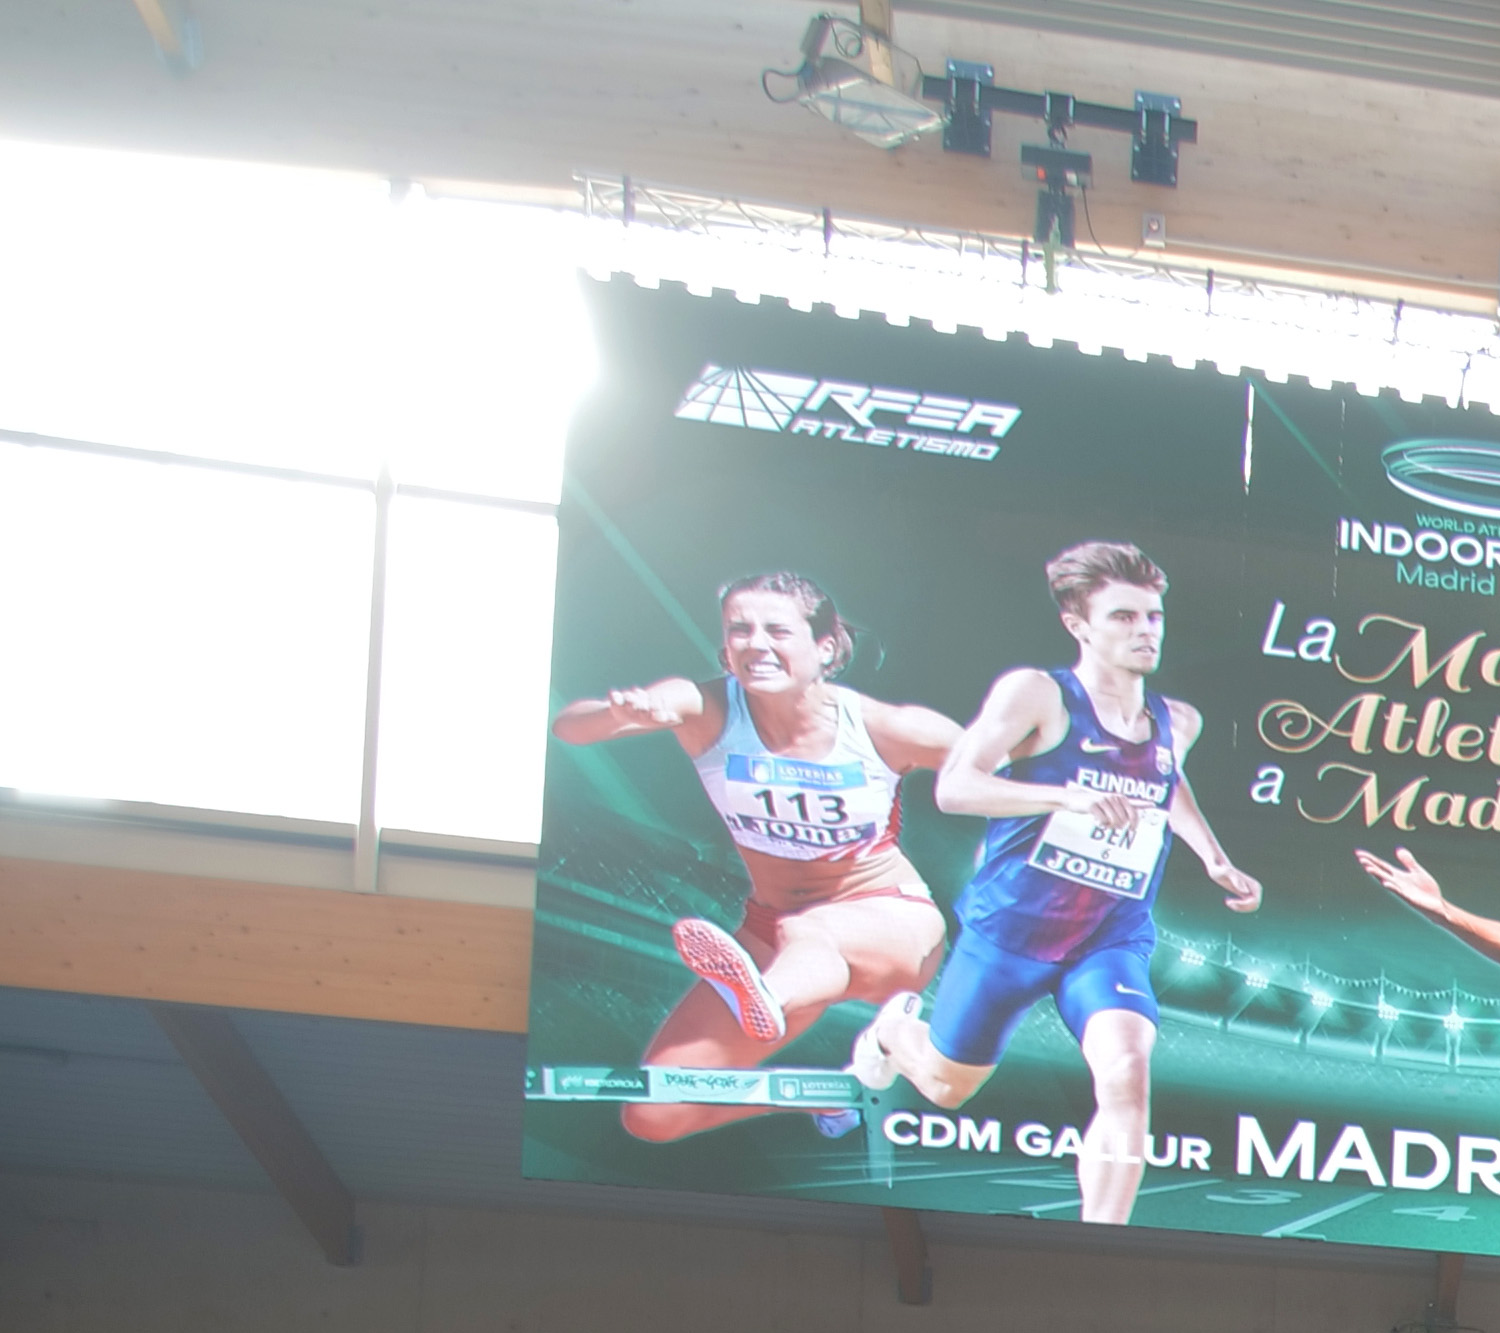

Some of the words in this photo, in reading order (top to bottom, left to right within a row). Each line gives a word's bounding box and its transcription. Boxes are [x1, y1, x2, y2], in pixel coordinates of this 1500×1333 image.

[804, 378, 1022, 438] RFEA
[791, 417, 1000, 461] ATLETISMO
[1416, 513, 1475, 534] WORLD
[1396, 561, 1496, 596] Madrid
[1262, 600, 1336, 662] La
[1250, 763, 1285, 804] a
[754, 789, 849, 825] 113
[1046, 850, 1133, 890] Joma
[1101, 848, 1112, 860] 6
[883, 1111, 1001, 1153] CDM
[1014, 1123, 1212, 1171] GALLUR
